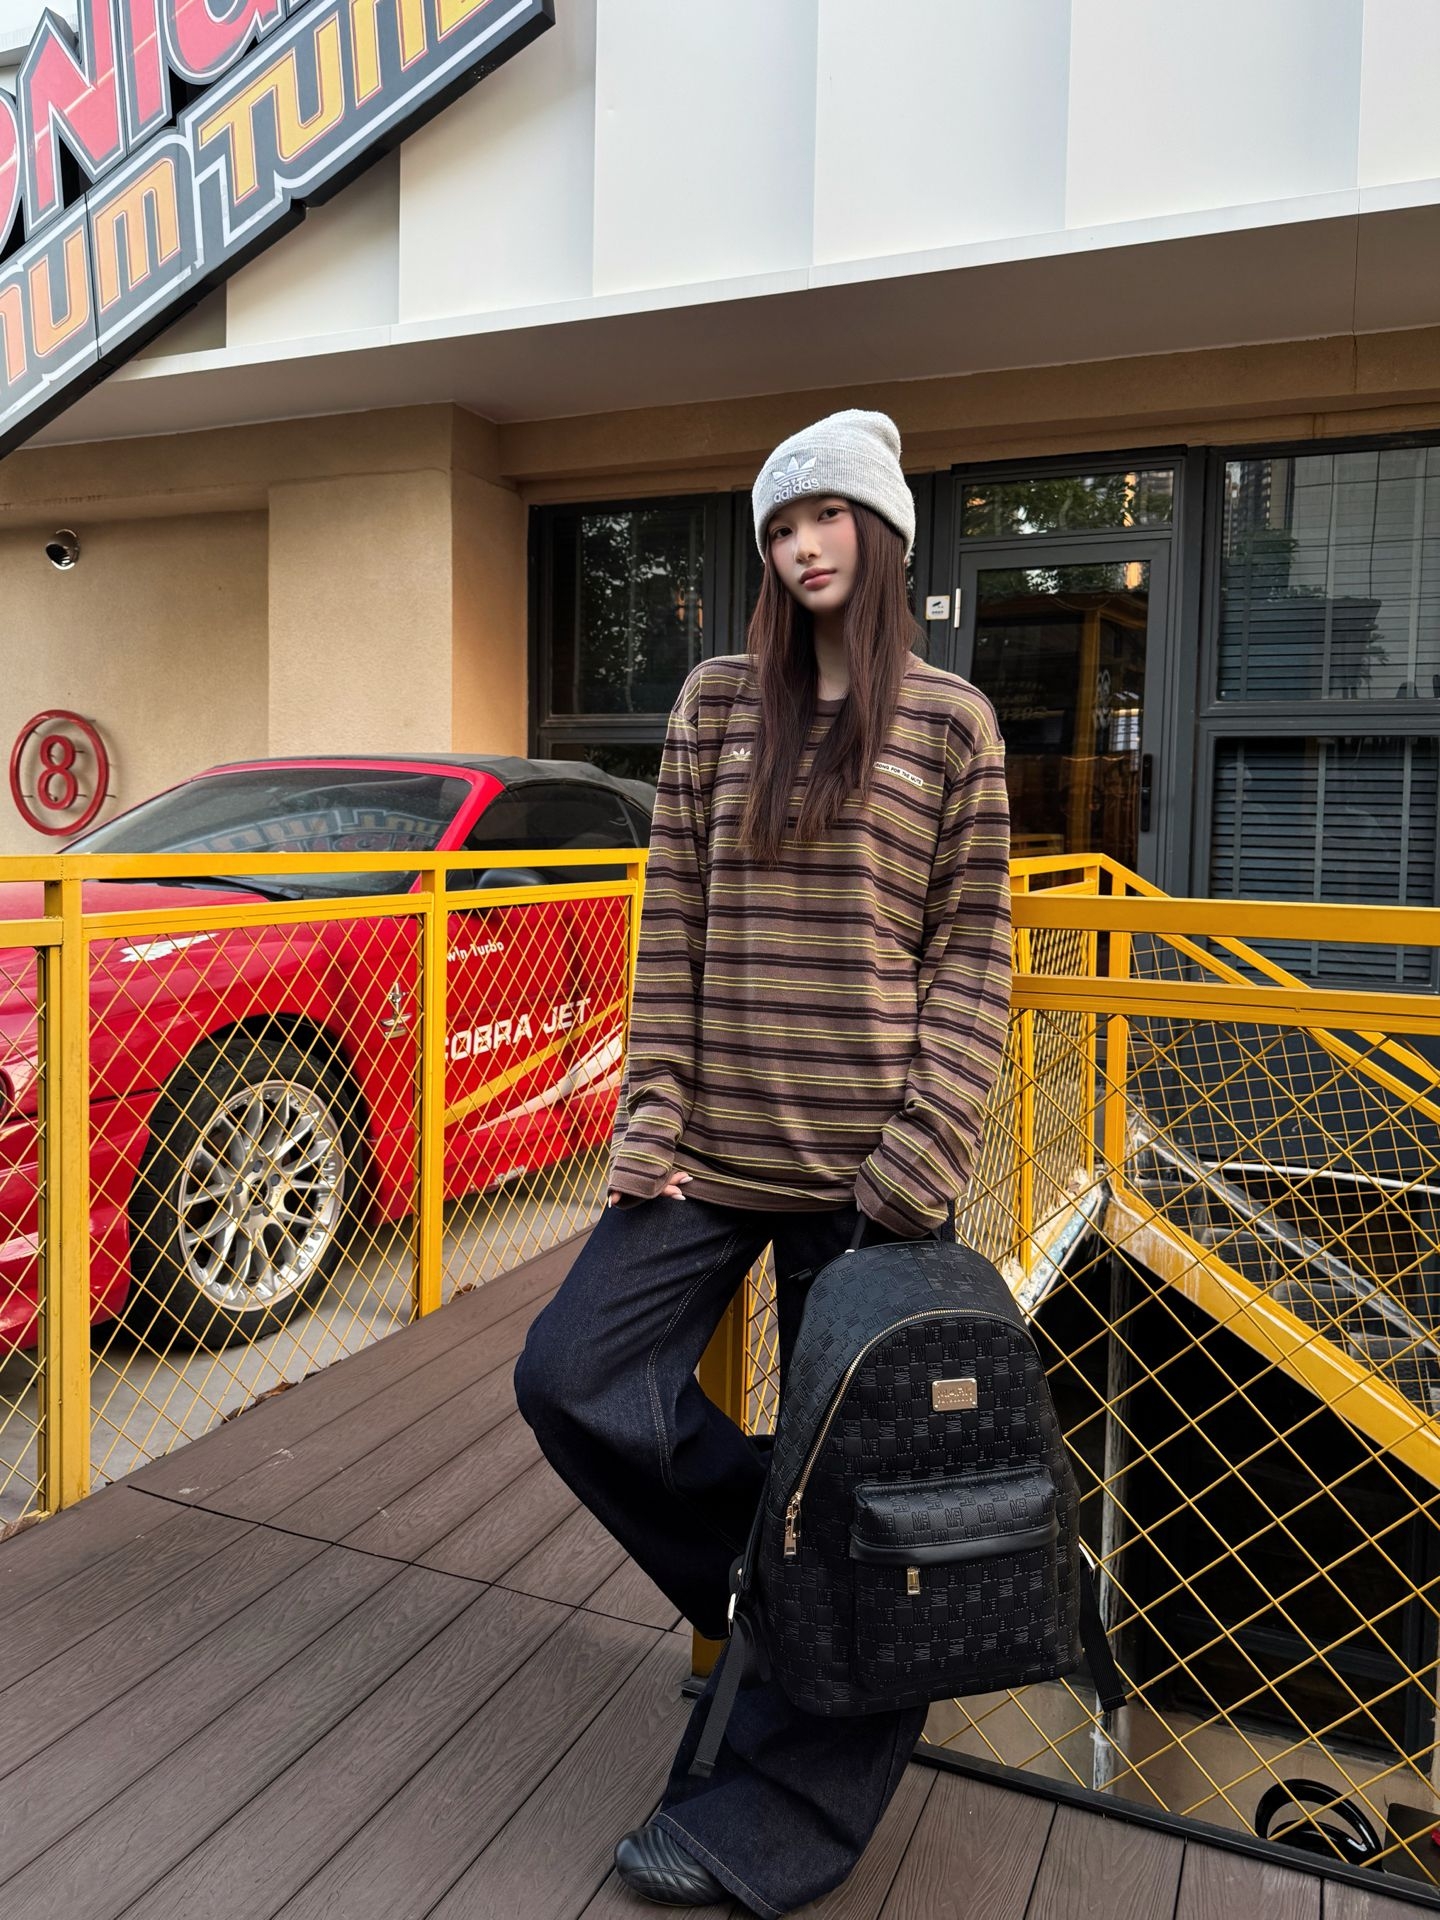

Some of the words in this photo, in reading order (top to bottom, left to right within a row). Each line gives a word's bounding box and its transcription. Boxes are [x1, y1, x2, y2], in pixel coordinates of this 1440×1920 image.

[773, 476, 819, 503] adidas
[38, 734, 78, 811] 8
[469, 938, 504, 957] Turbo
[543, 997, 591, 1034] JET
